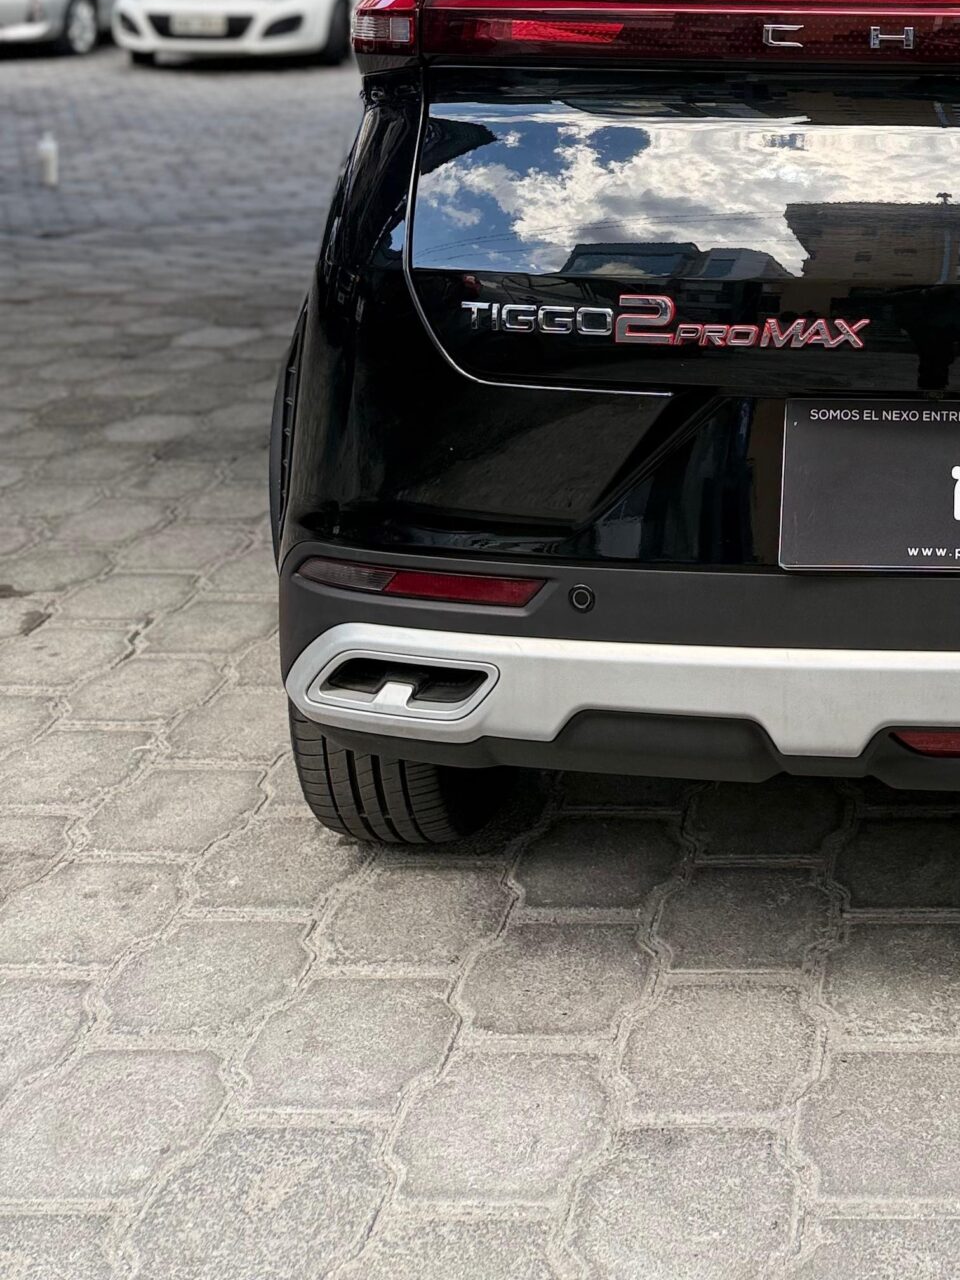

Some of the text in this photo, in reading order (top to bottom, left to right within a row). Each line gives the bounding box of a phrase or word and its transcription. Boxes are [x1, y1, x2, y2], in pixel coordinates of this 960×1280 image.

[809, 409, 860, 421] SOMOS
[863, 410, 879, 421] EL
[882, 410, 919, 422] NEXO
